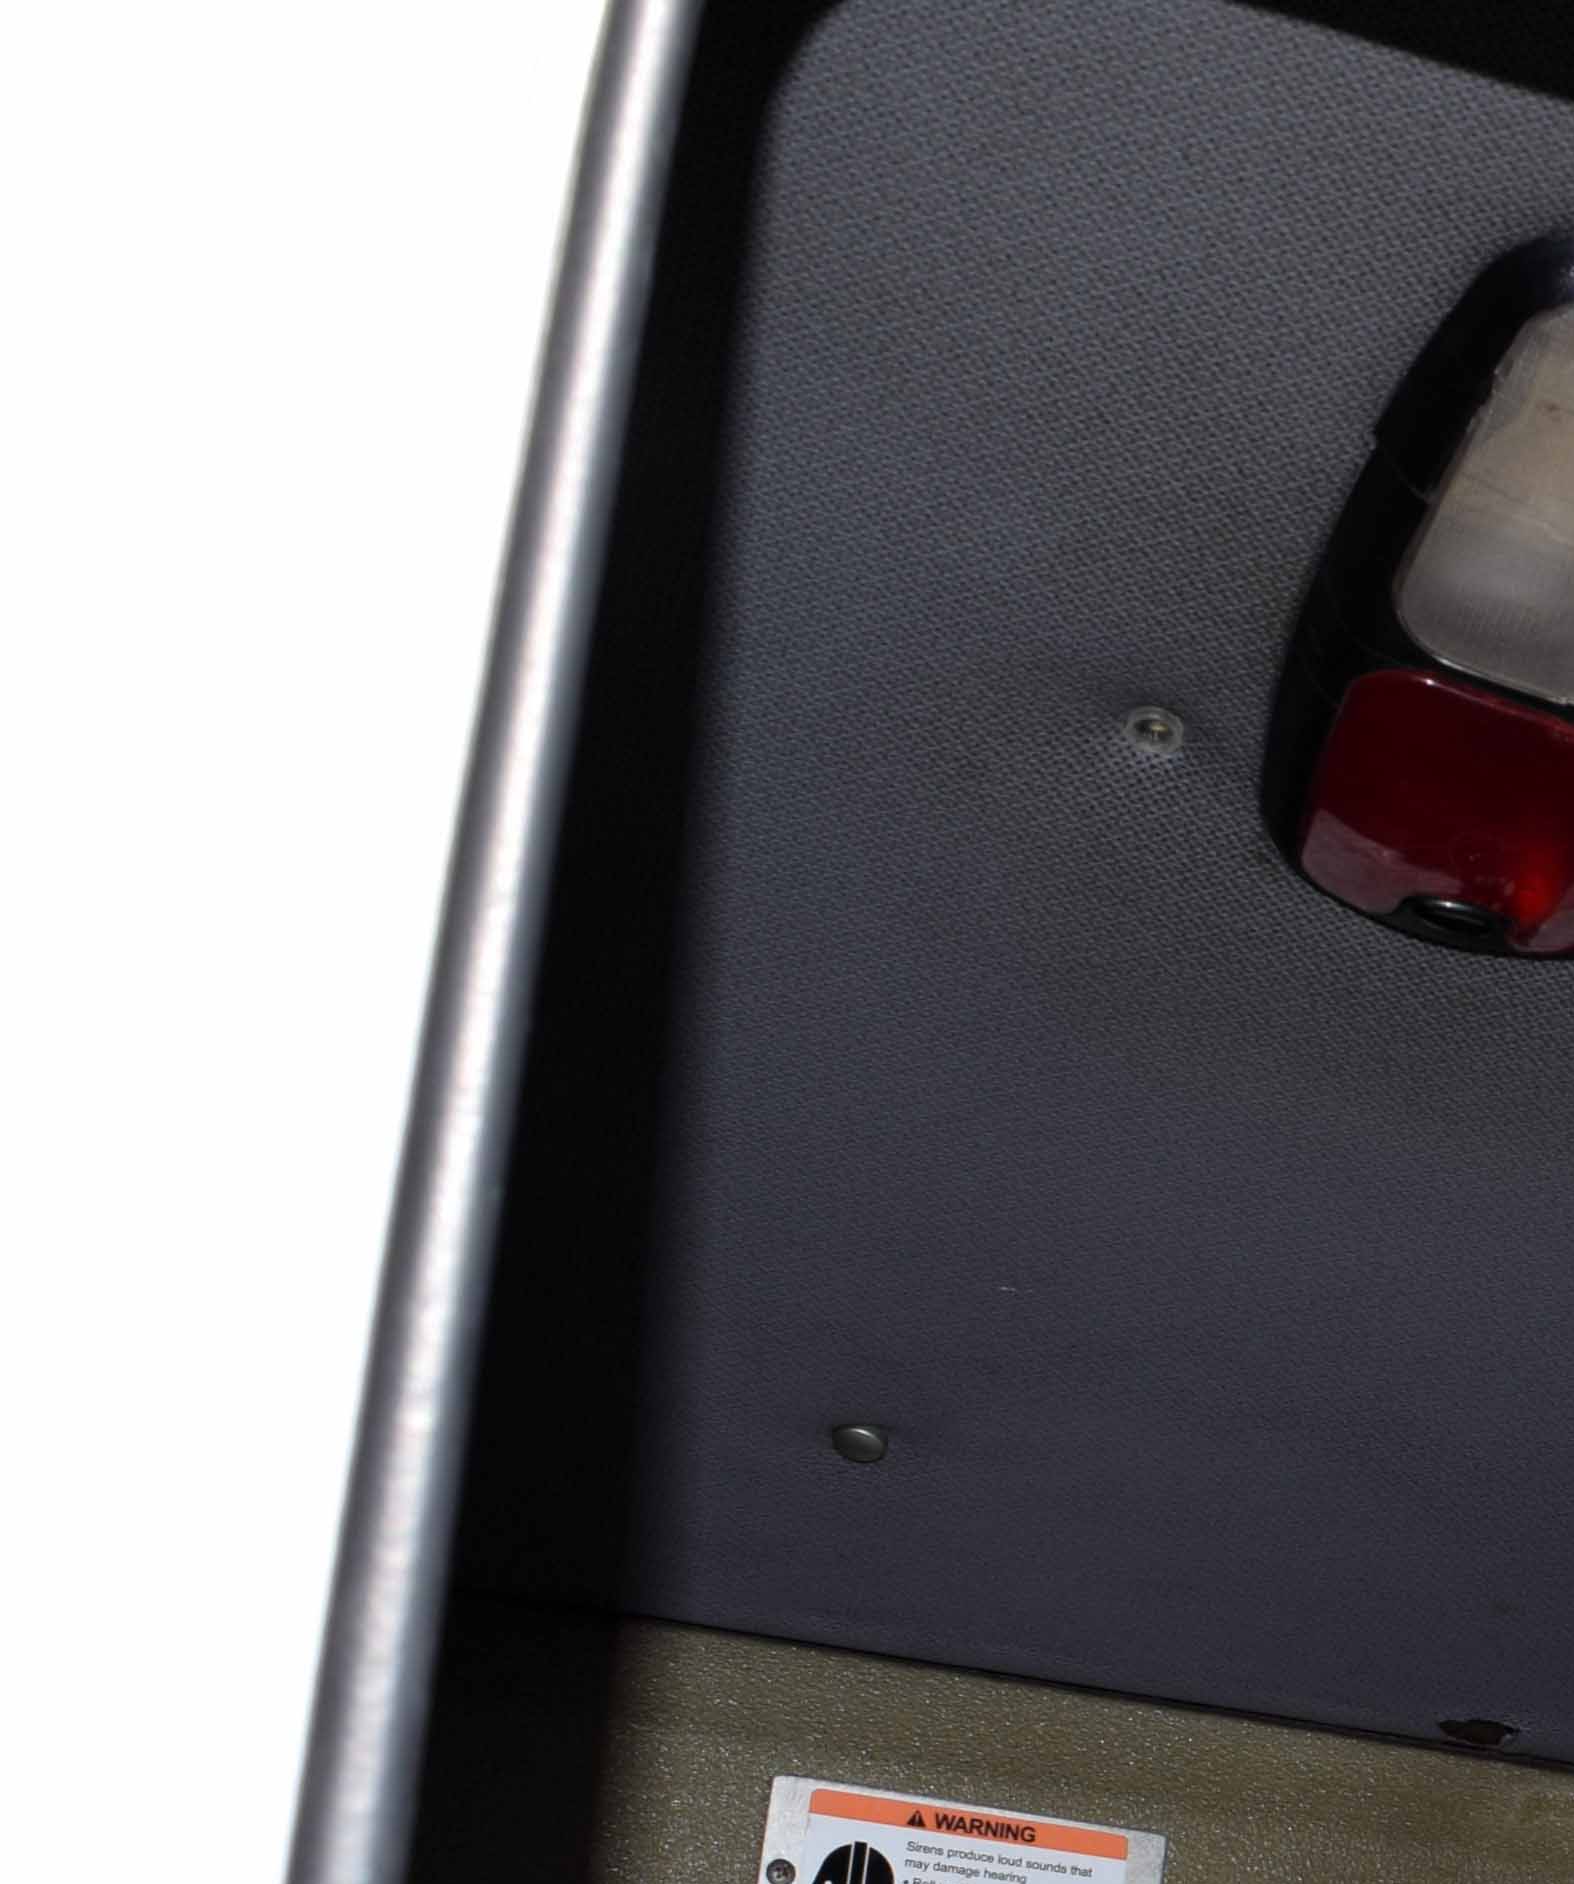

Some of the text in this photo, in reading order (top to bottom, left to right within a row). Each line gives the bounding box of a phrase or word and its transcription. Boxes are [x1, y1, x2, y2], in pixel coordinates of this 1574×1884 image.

[935, 1812, 1036, 1842] WARNING
[904, 1859, 929, 1872] may
[933, 1862, 980, 1878] damage
[906, 1841, 1093, 1877] Sirens produce loud sounds that
